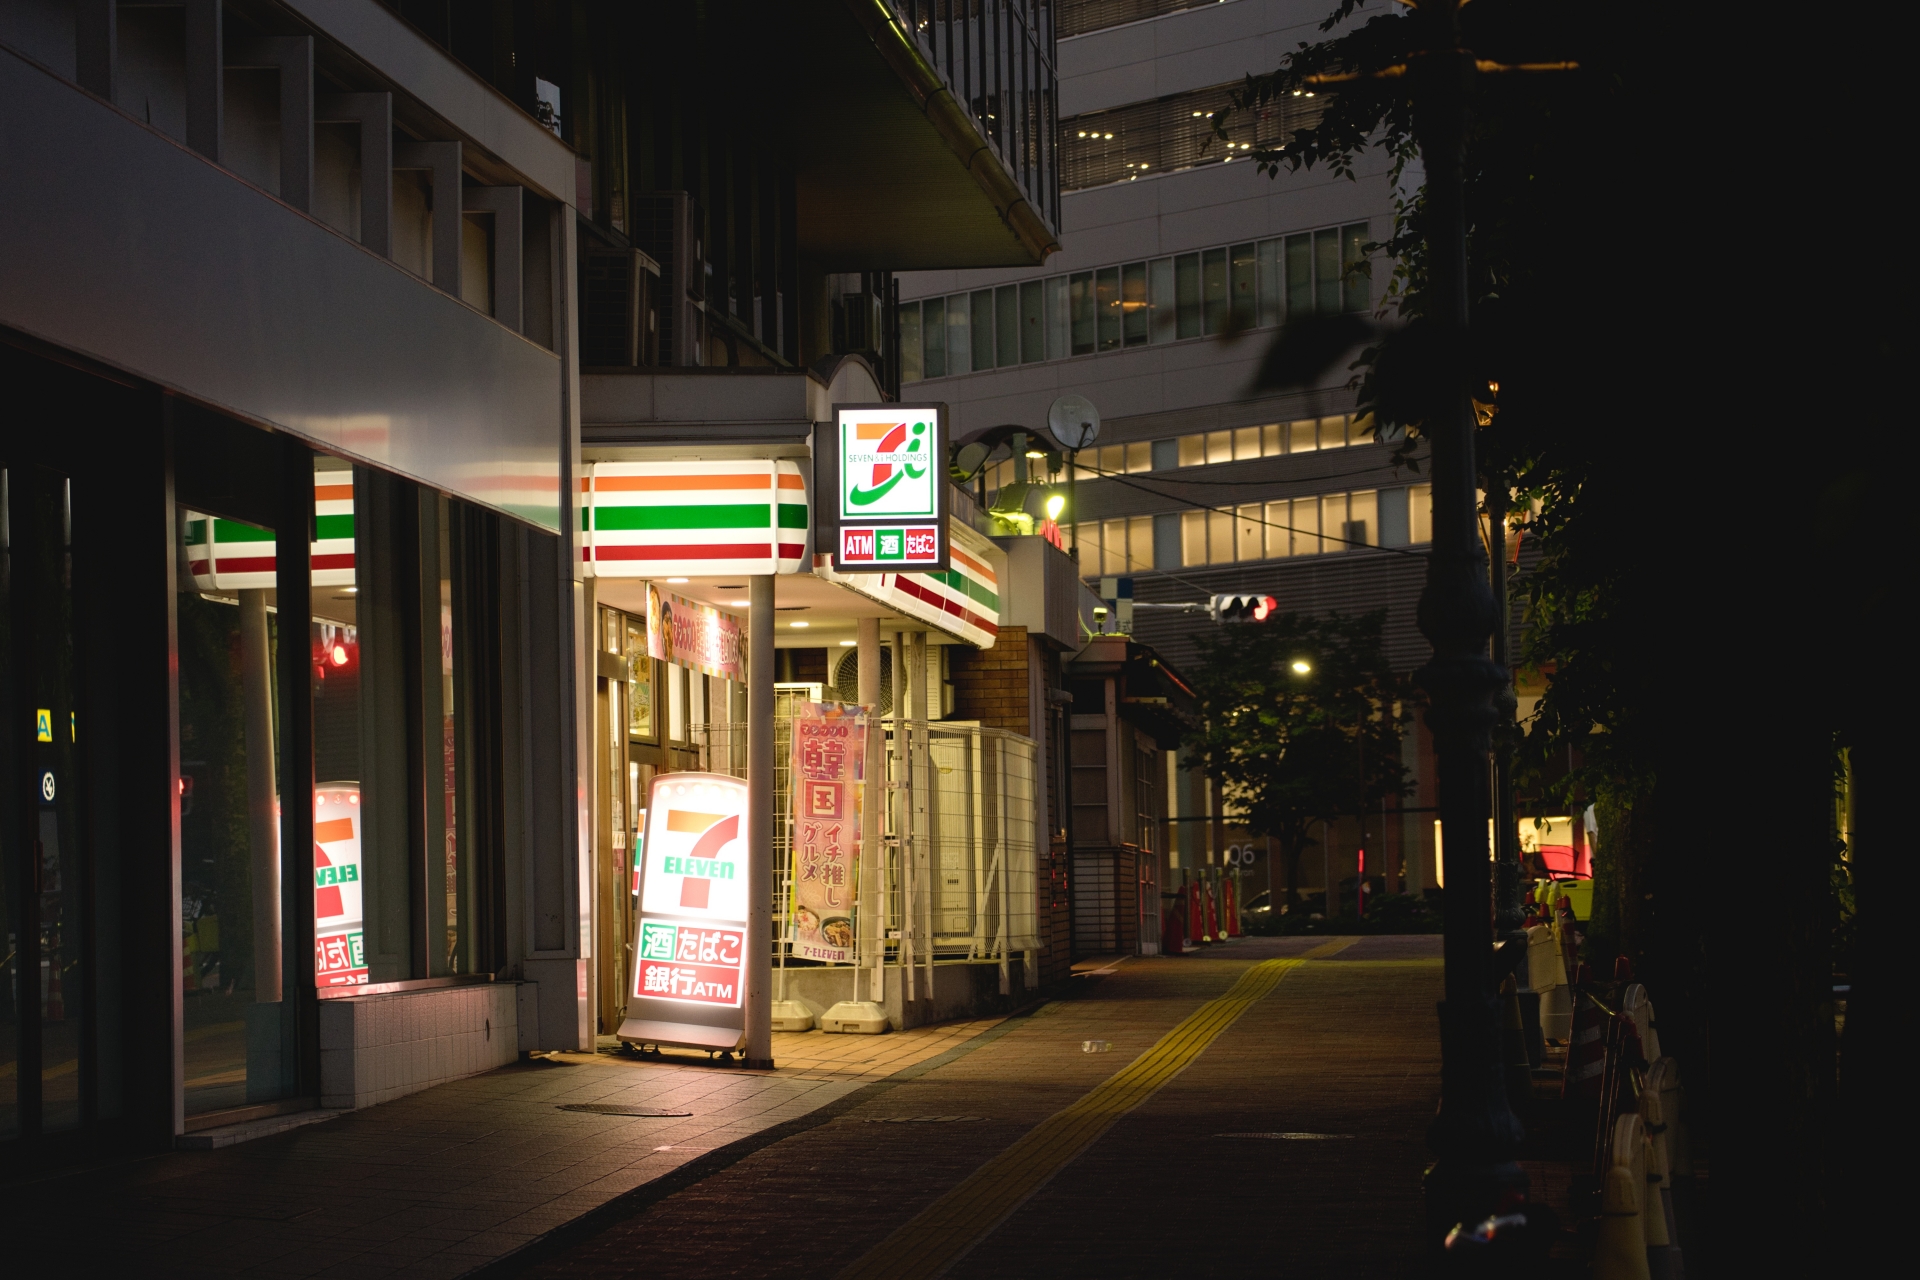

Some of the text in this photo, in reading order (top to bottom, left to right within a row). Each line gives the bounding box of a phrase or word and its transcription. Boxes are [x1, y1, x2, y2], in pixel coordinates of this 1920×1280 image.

[885, 453, 928, 462] HOLDINGS
[845, 534, 935, 555] ATM 酒 たばこ
[802, 738, 845, 821] 韓国
[801, 823, 822, 882] グルメ
[821, 823, 845, 908] イチ推し
[643, 925, 741, 964] 酒 たばこ
